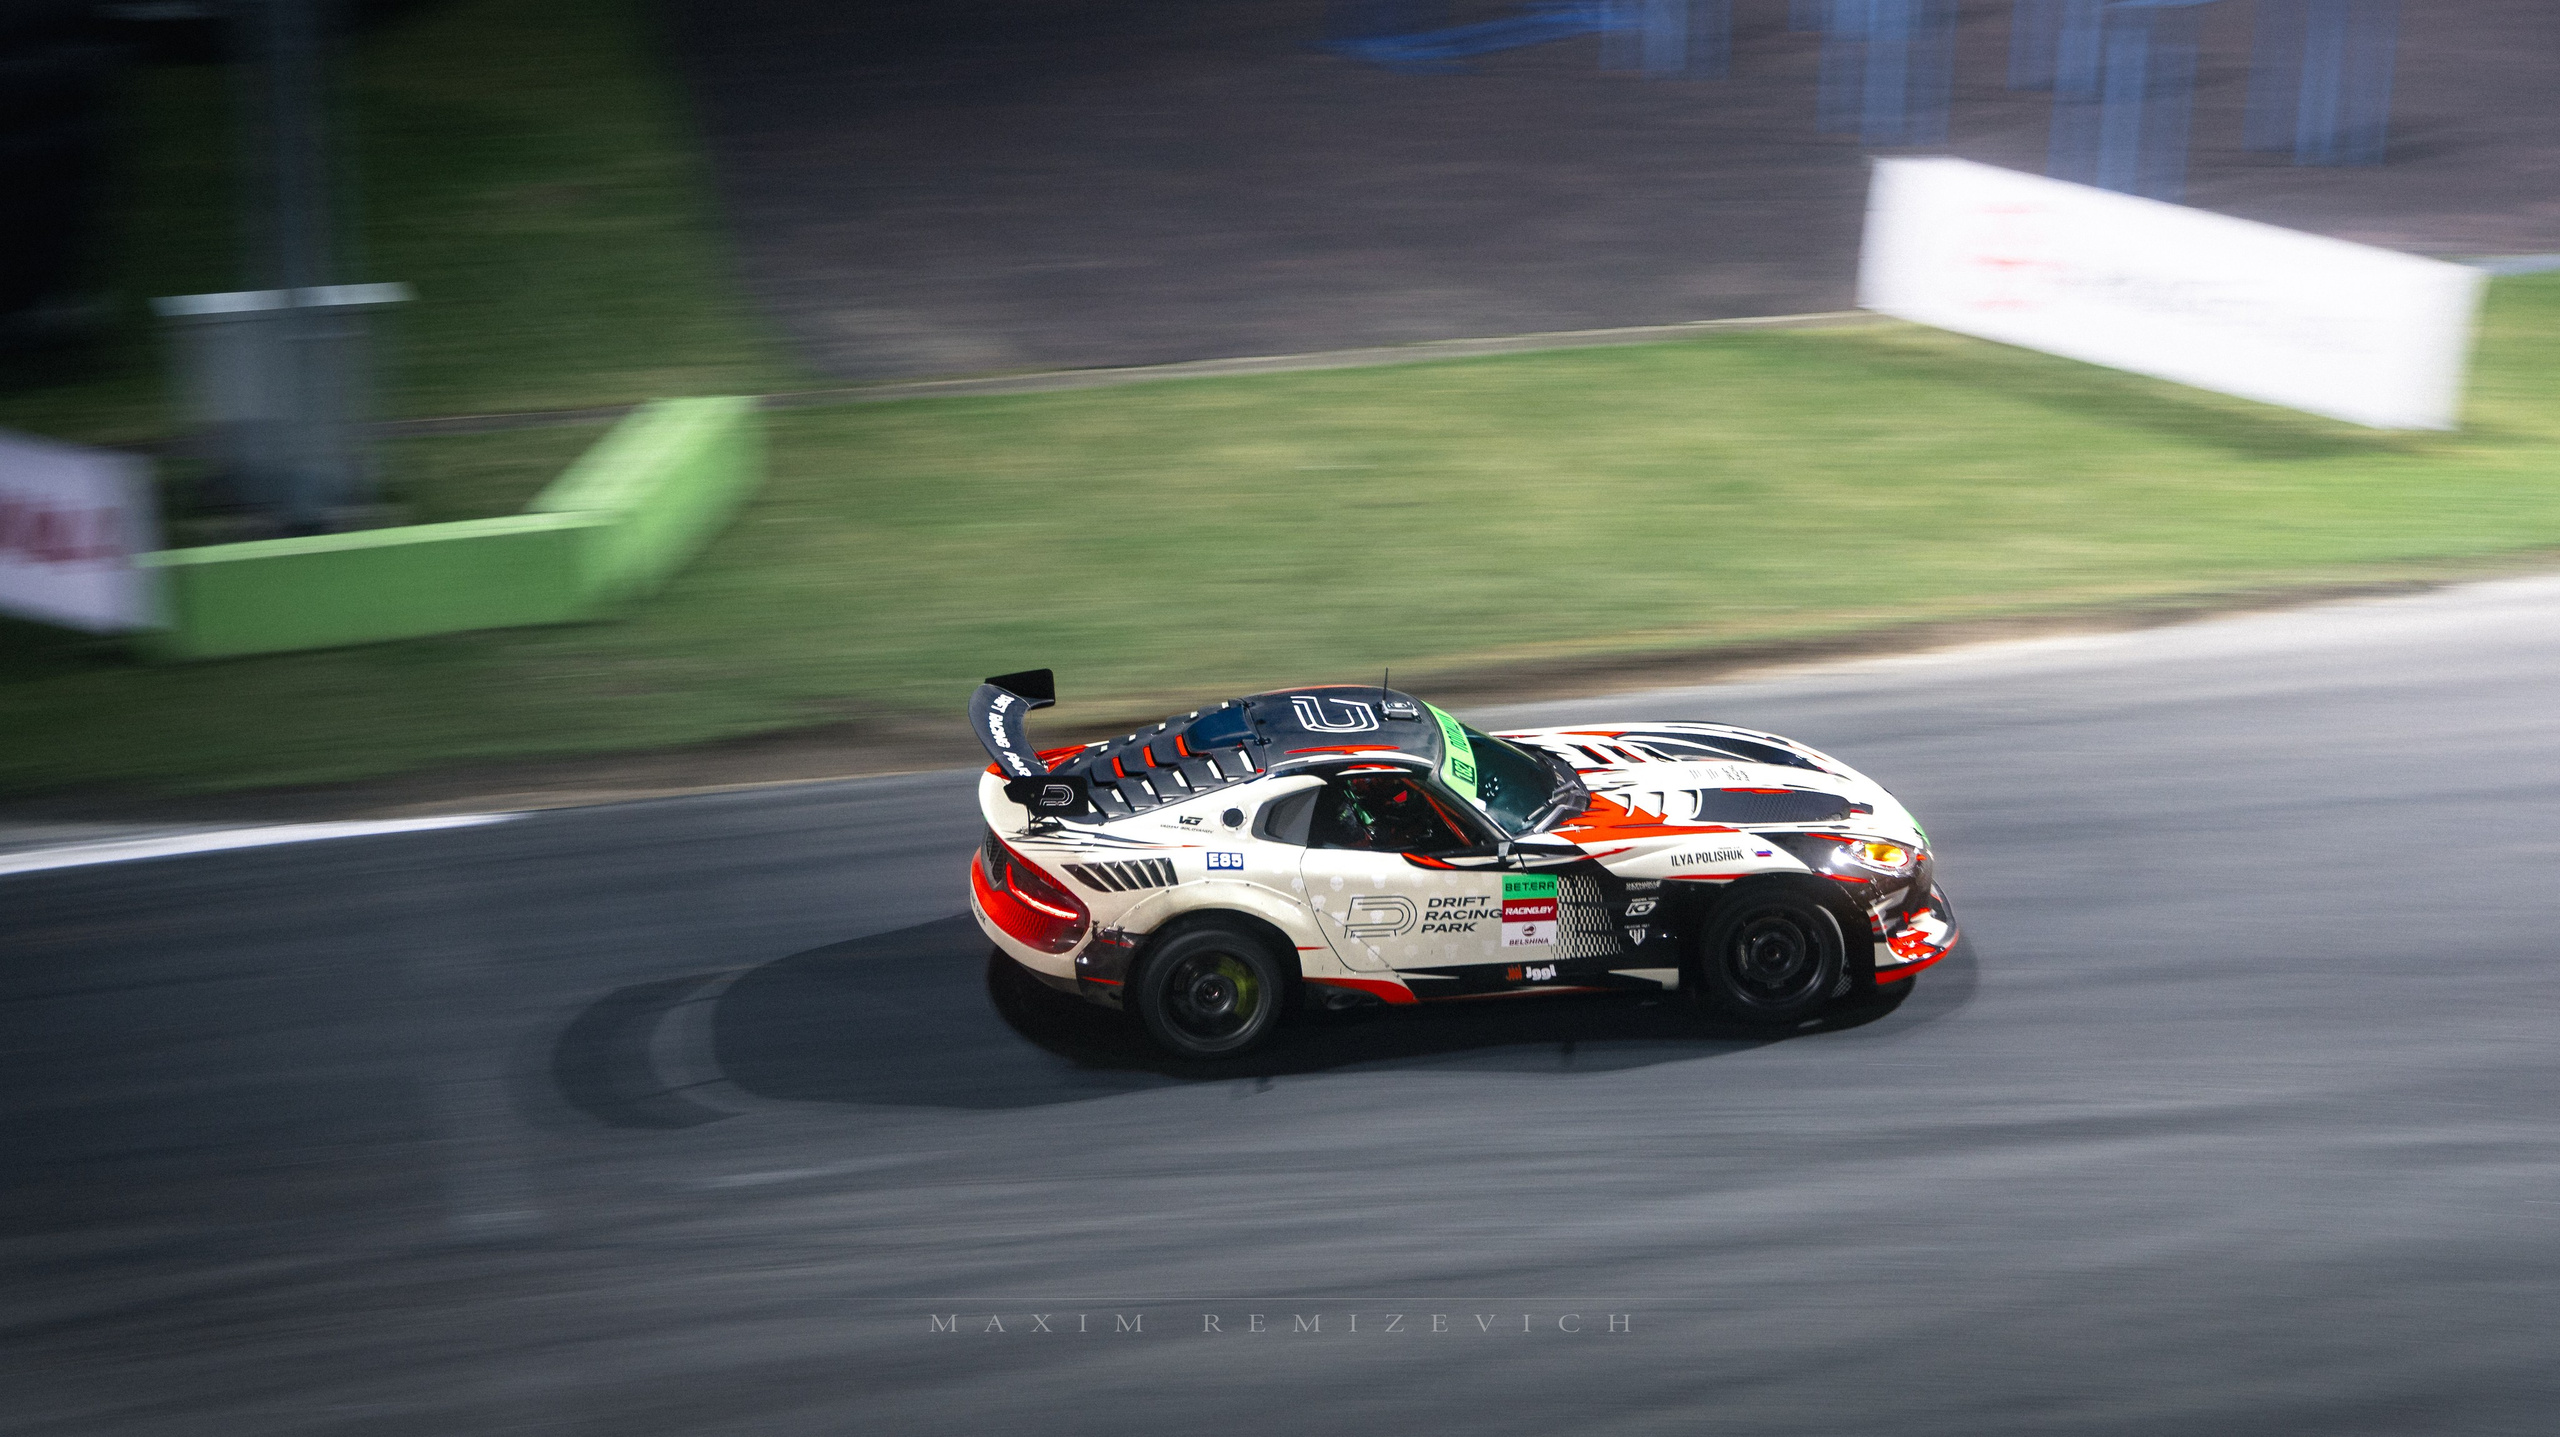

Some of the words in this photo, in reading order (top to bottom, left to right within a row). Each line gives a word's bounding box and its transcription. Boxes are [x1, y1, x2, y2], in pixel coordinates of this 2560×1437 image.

[1003, 751, 1031, 776] PAR
[1454, 759, 1474, 783] 182
[1208, 853, 1242, 867] E85
[1671, 853, 1694, 867] ILYA
[1695, 850, 1744, 864] POLISHUK
[1428, 896, 1490, 908] DRIFT
[1424, 909, 1502, 921] RACING
[1421, 922, 1478, 933] PARK
[1509, 937, 1550, 946] BELSHINA
